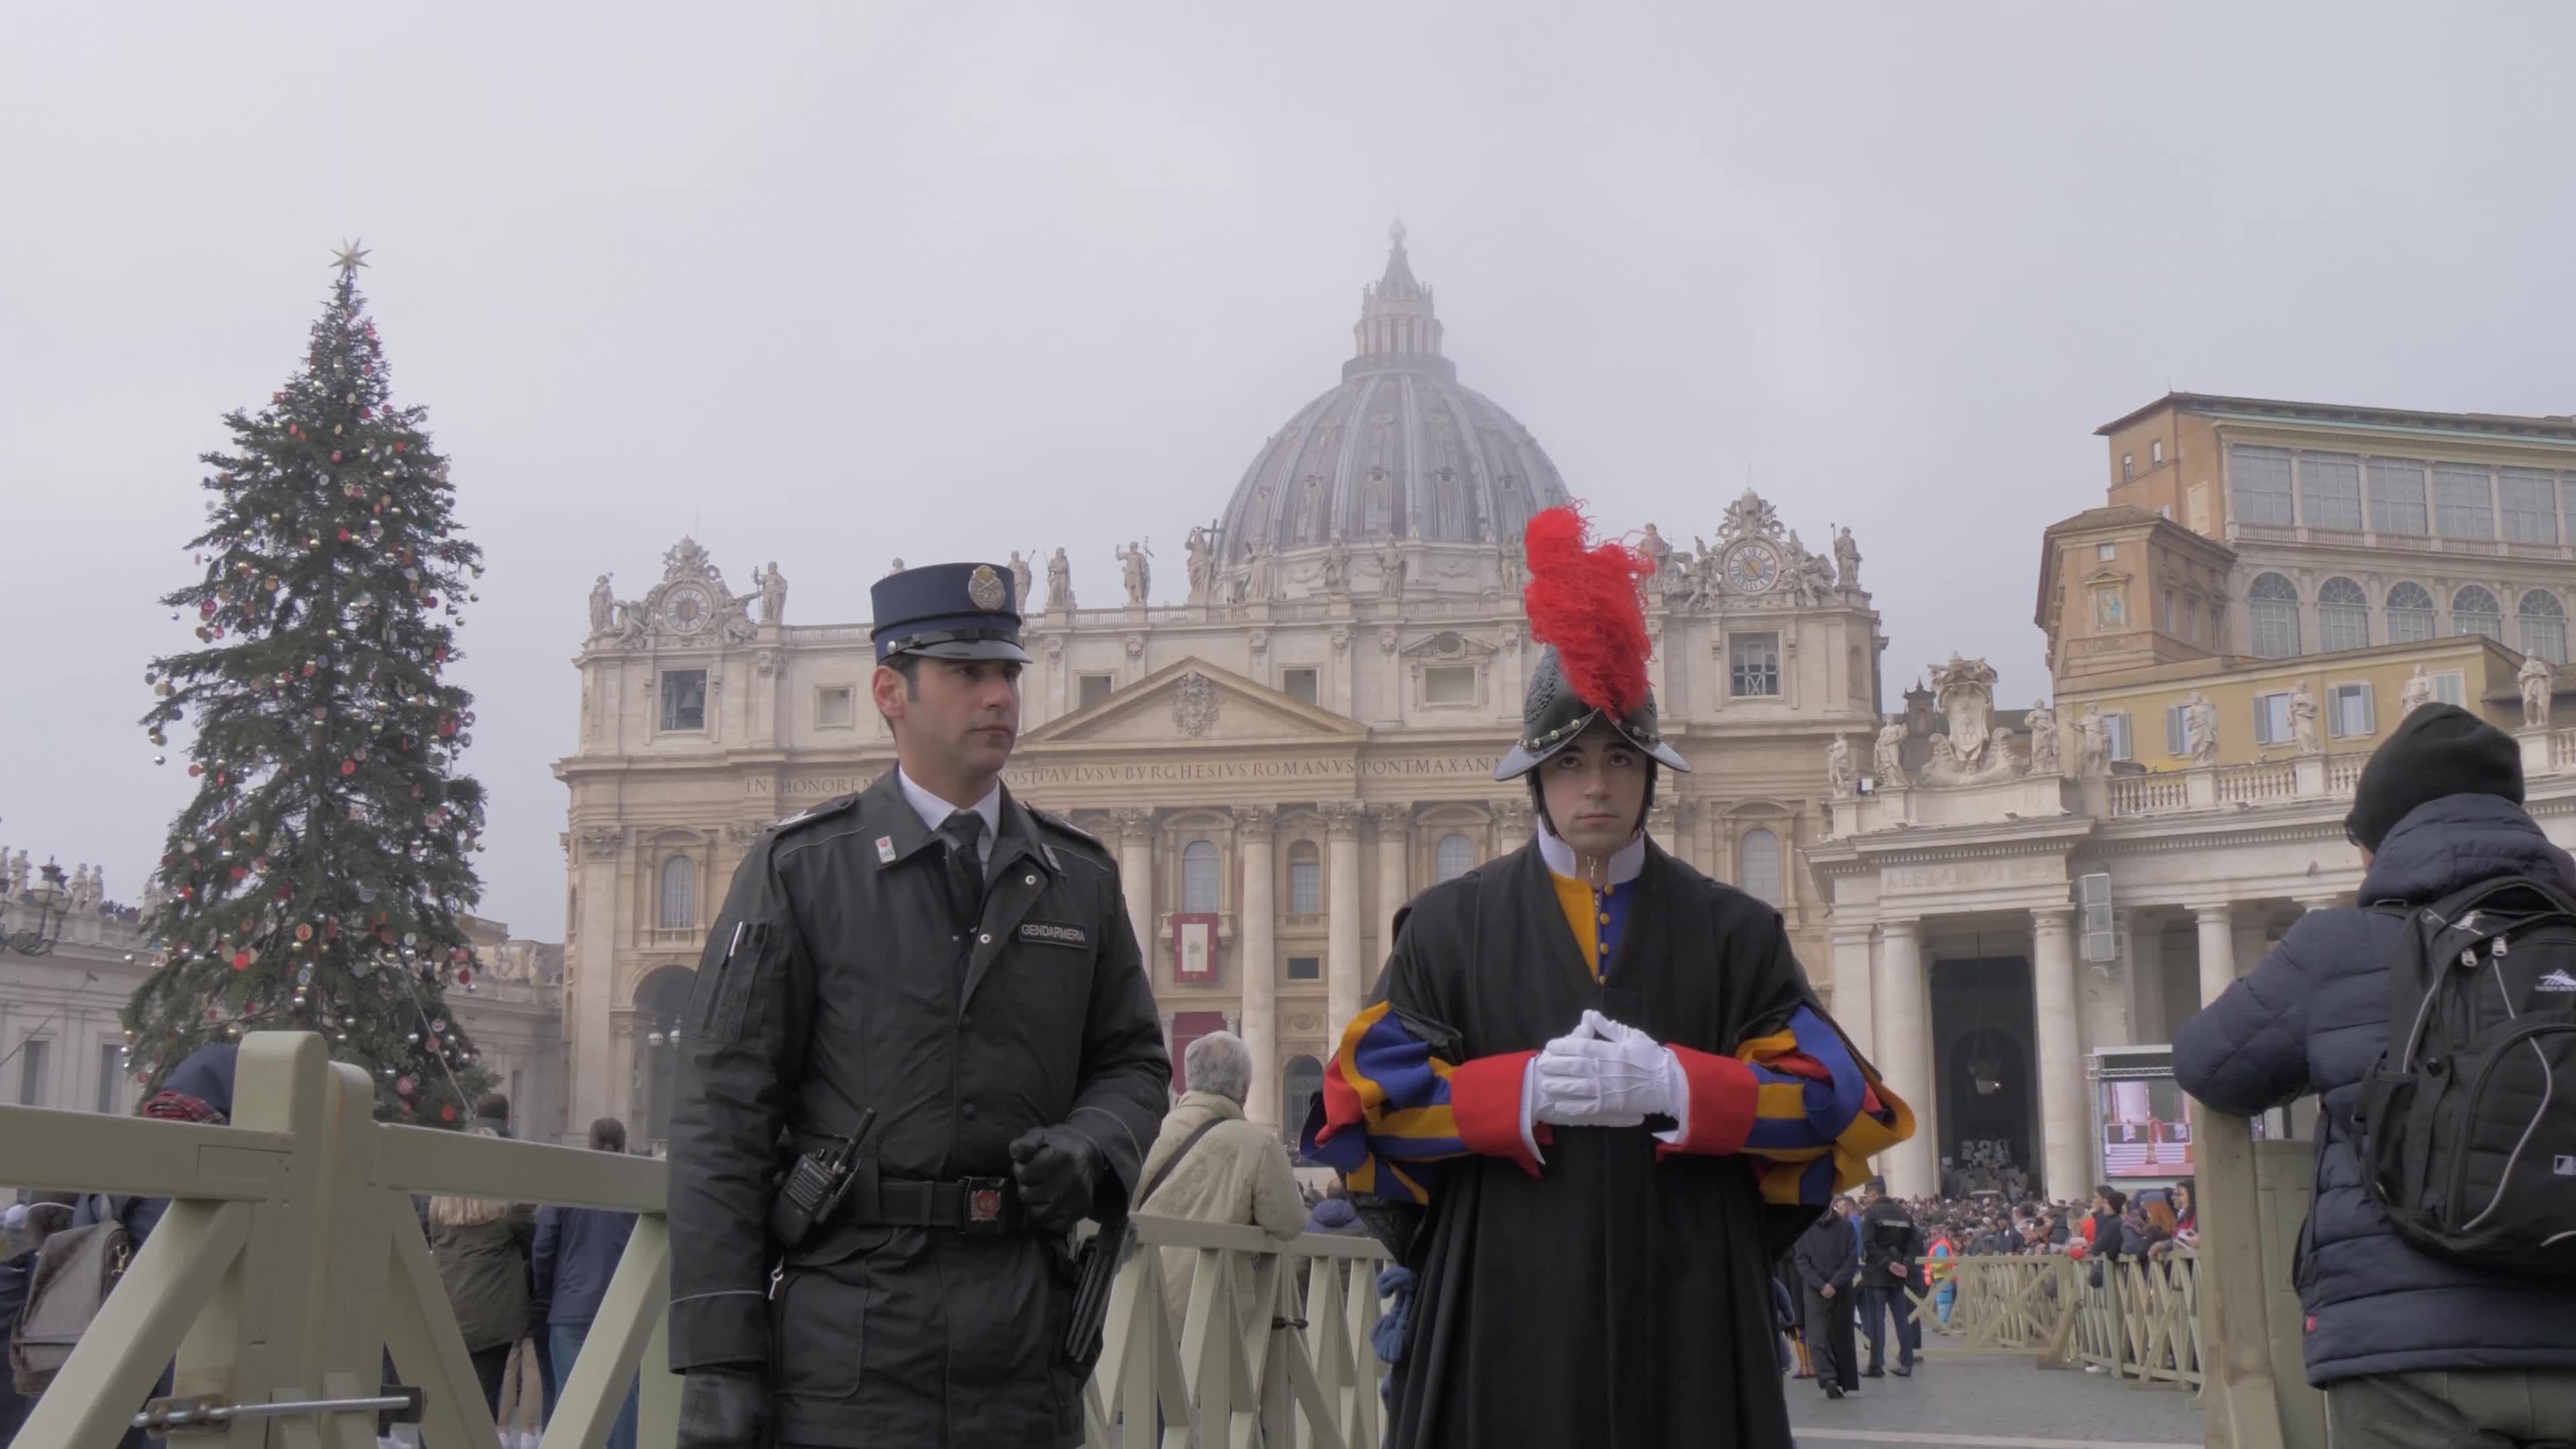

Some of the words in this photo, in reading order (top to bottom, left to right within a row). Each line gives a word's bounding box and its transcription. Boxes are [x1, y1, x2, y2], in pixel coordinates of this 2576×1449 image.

[747, 778, 767, 792] IN
[1125, 763, 1246, 780] BVRGHESIVS
[1253, 759, 1354, 776] ROMANVS
[1021, 924, 1085, 943] GENDARMERIA
